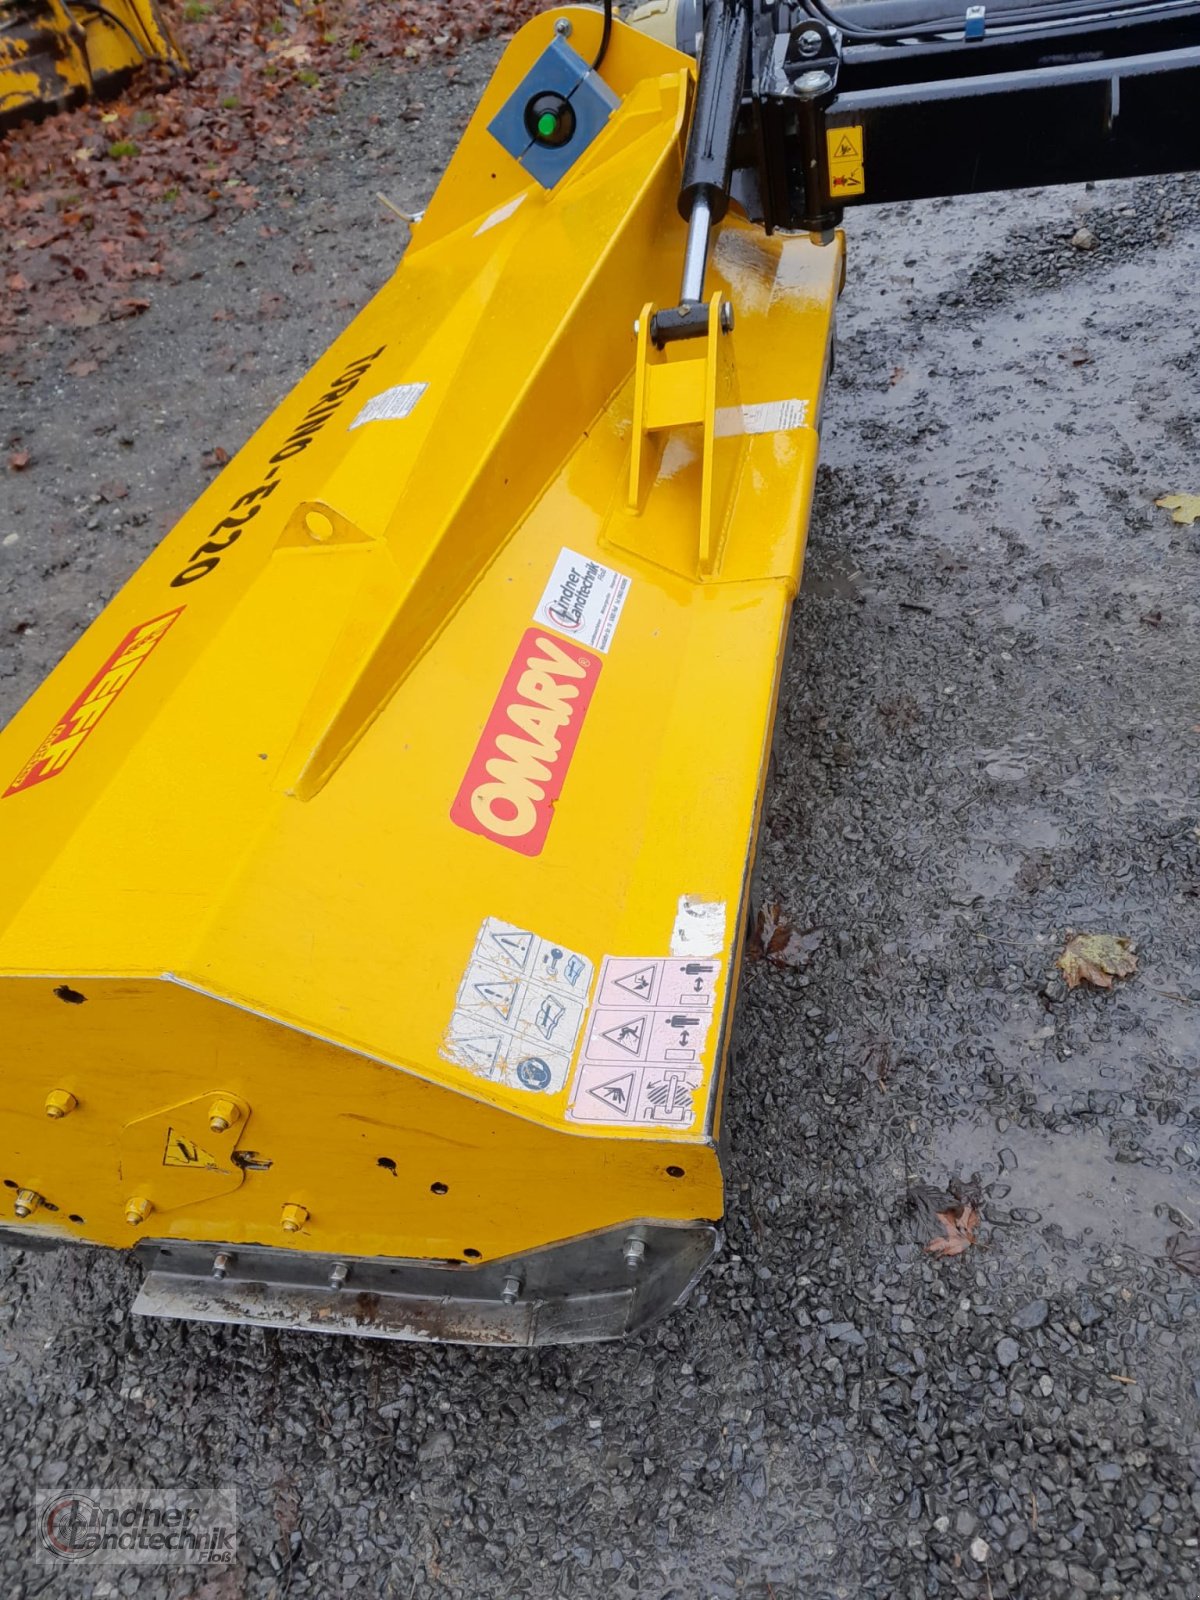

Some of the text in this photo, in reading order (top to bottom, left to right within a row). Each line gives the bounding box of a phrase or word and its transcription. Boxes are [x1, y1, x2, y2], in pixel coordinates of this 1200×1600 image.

[170, 345, 387, 587] TORINO-E220
[549, 567, 581, 618] Lindner
[564, 561, 600, 624] Landtechnik
[471, 637, 587, 836] OMARV
